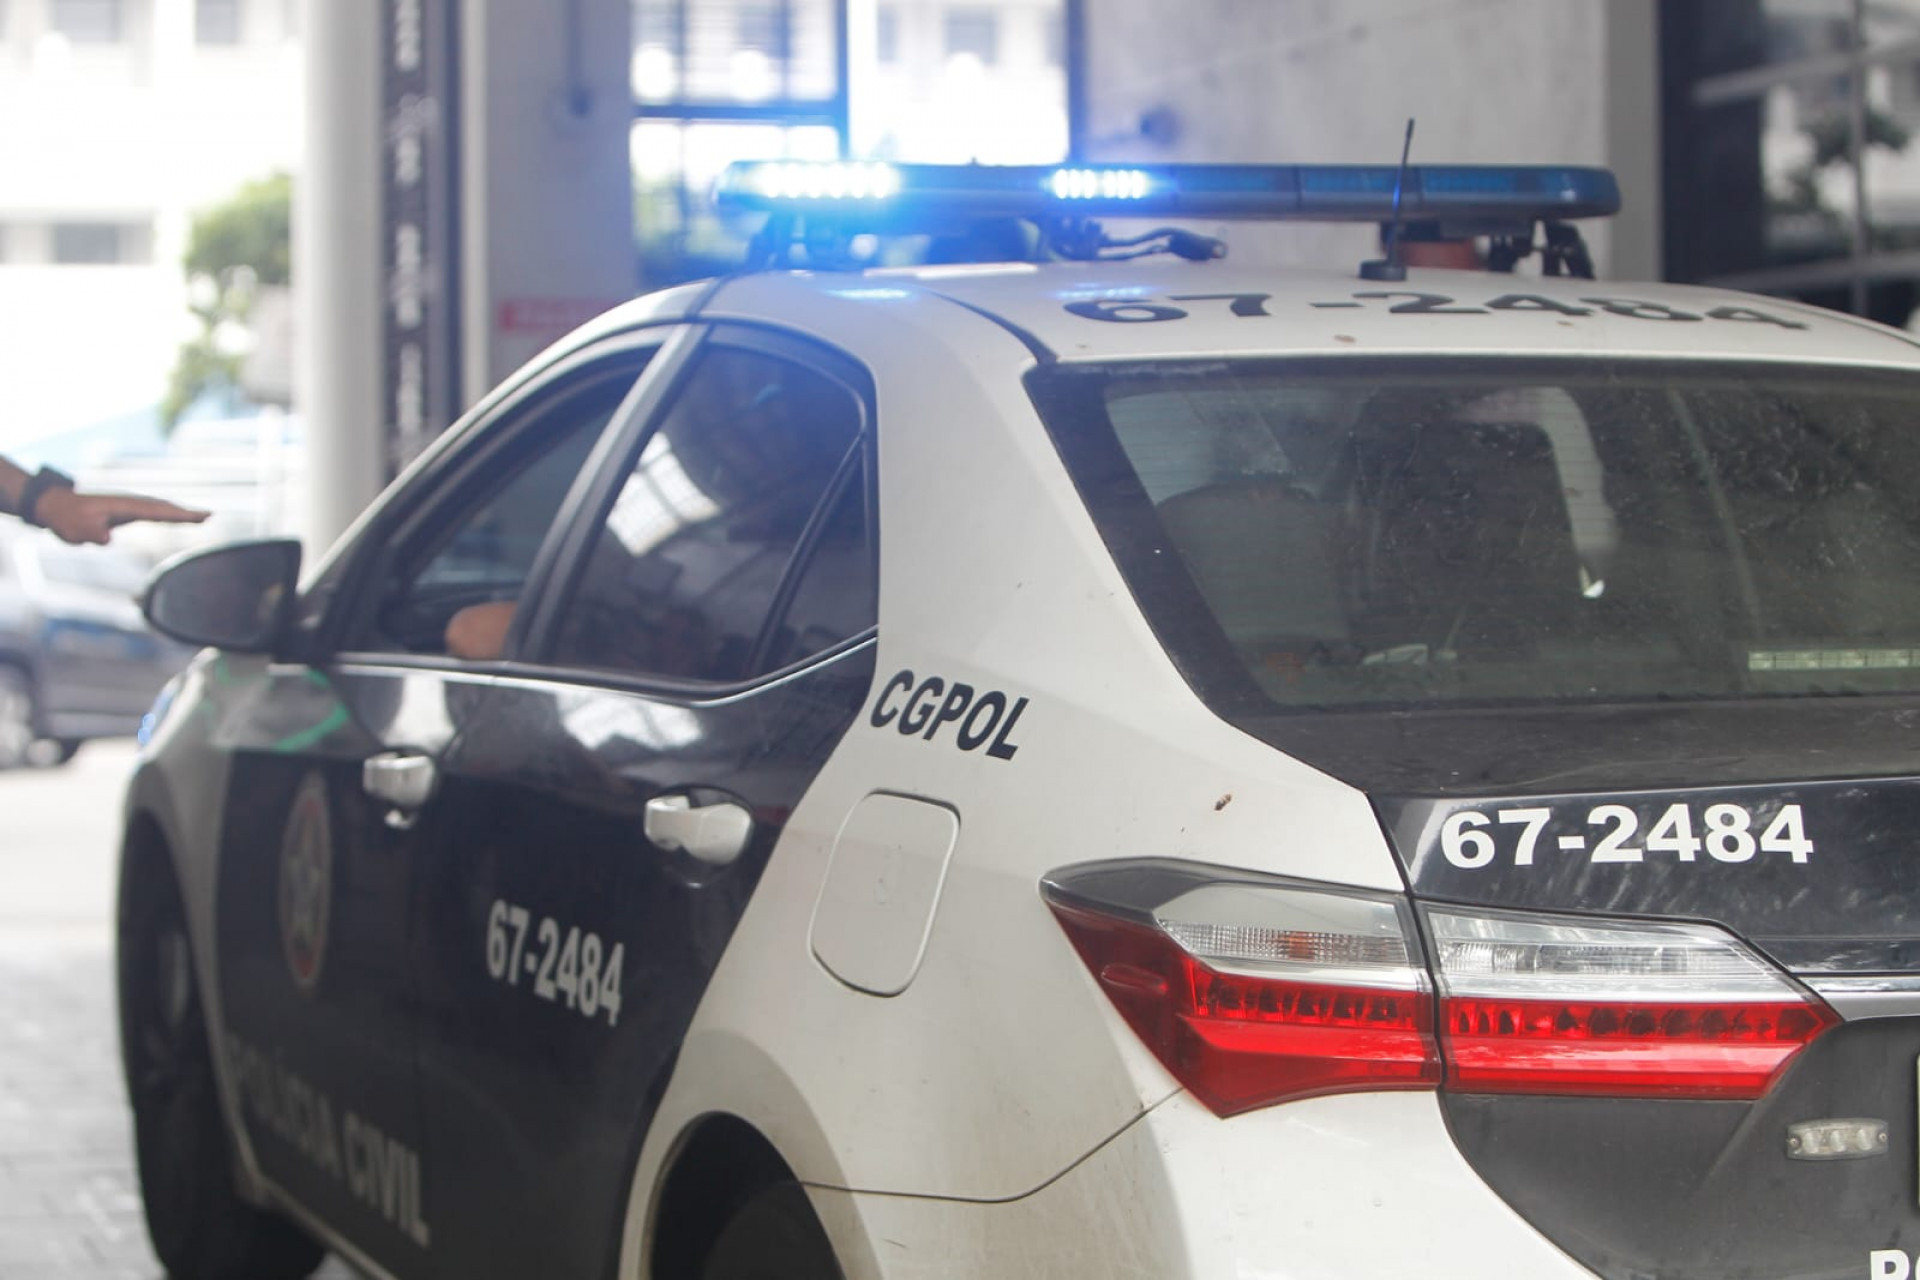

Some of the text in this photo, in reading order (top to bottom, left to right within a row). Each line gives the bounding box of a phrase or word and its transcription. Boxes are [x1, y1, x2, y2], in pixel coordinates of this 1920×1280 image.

[1063, 293, 1810, 330] 67-2484
[871, 669, 1029, 761] CGPOL
[1440, 803, 1814, 869] 67-2484
[487, 898, 624, 1027] 67-2484
[343, 1110, 430, 1247] CIVIL
